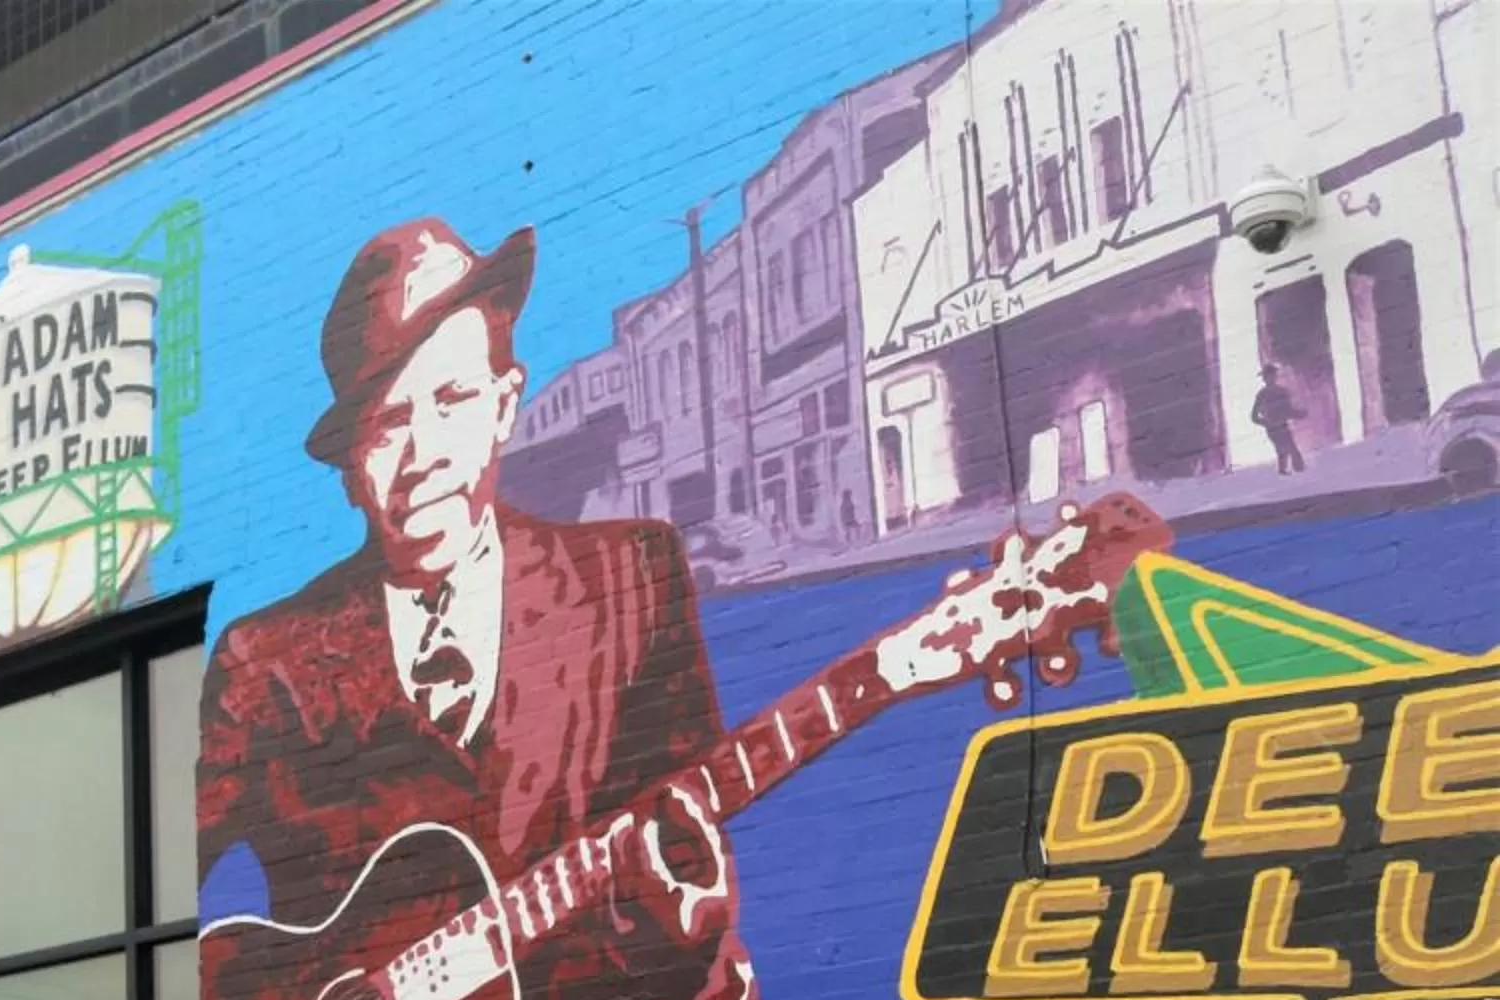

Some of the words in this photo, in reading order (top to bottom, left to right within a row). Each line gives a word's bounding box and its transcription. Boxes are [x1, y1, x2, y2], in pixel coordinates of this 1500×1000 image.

[3, 290, 119, 386] ADAM
[922, 294, 1025, 349] HARLEM
[12, 360, 112, 448] HATS
[1042, 680, 1500, 862] DEE
[984, 855, 1500, 997] ELLU
